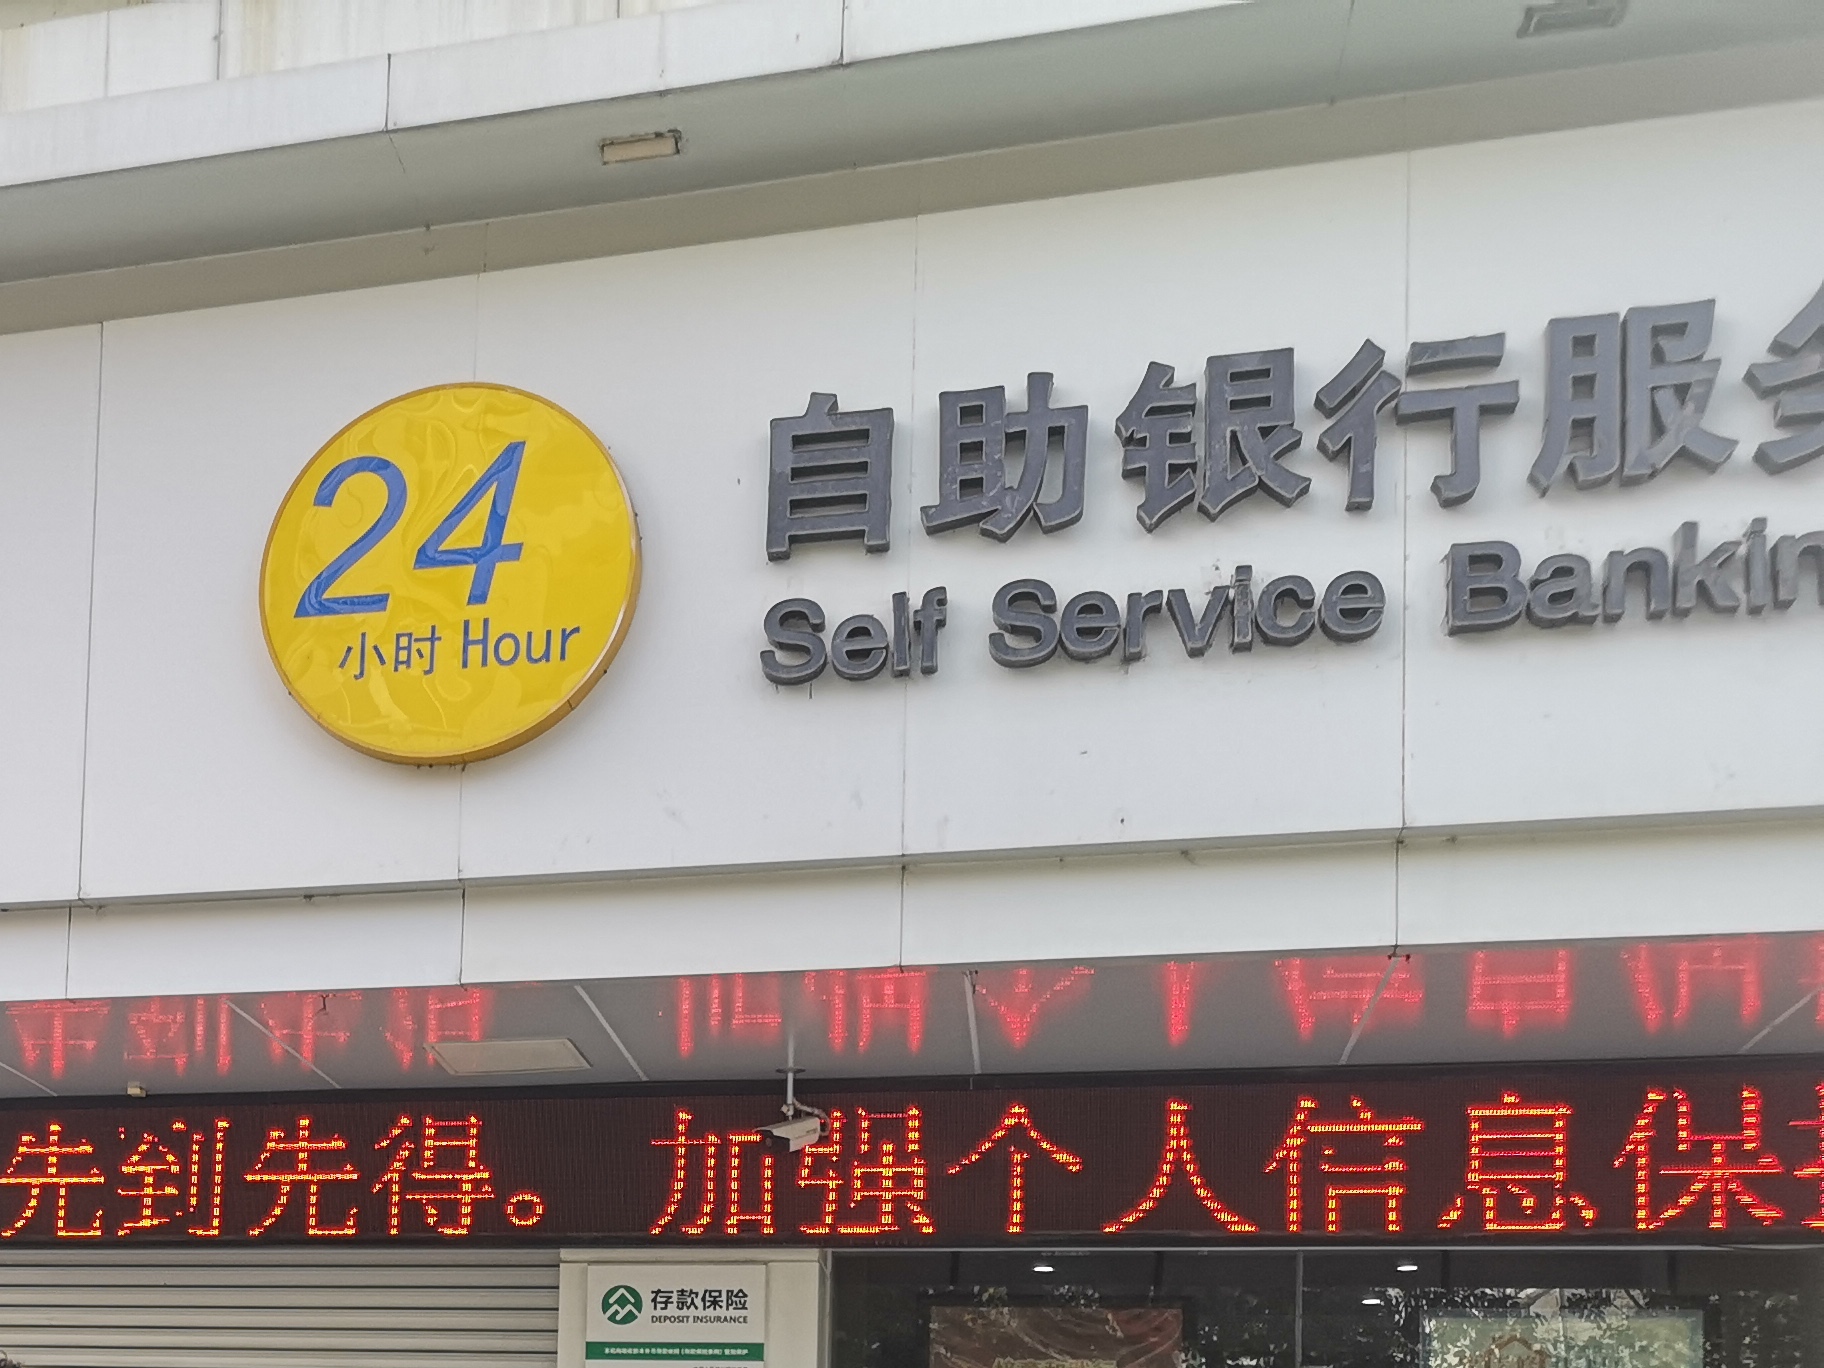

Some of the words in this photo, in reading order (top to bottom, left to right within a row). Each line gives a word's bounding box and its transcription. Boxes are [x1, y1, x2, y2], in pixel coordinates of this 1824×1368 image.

[293, 440, 527, 618] 24
[339, 625, 442, 679] 小时
[461, 618, 581, 669] Hour
[759, 586, 947, 685] Self
[988, 565, 1386, 669] Service
[650, 1084, 1824, 1236] 加强个人信息保
[650, 1288, 749, 1312] 存款保险
[651, 1315, 690, 1324] DEPOSIT
[693, 1315, 749, 1324] INSURANCE
